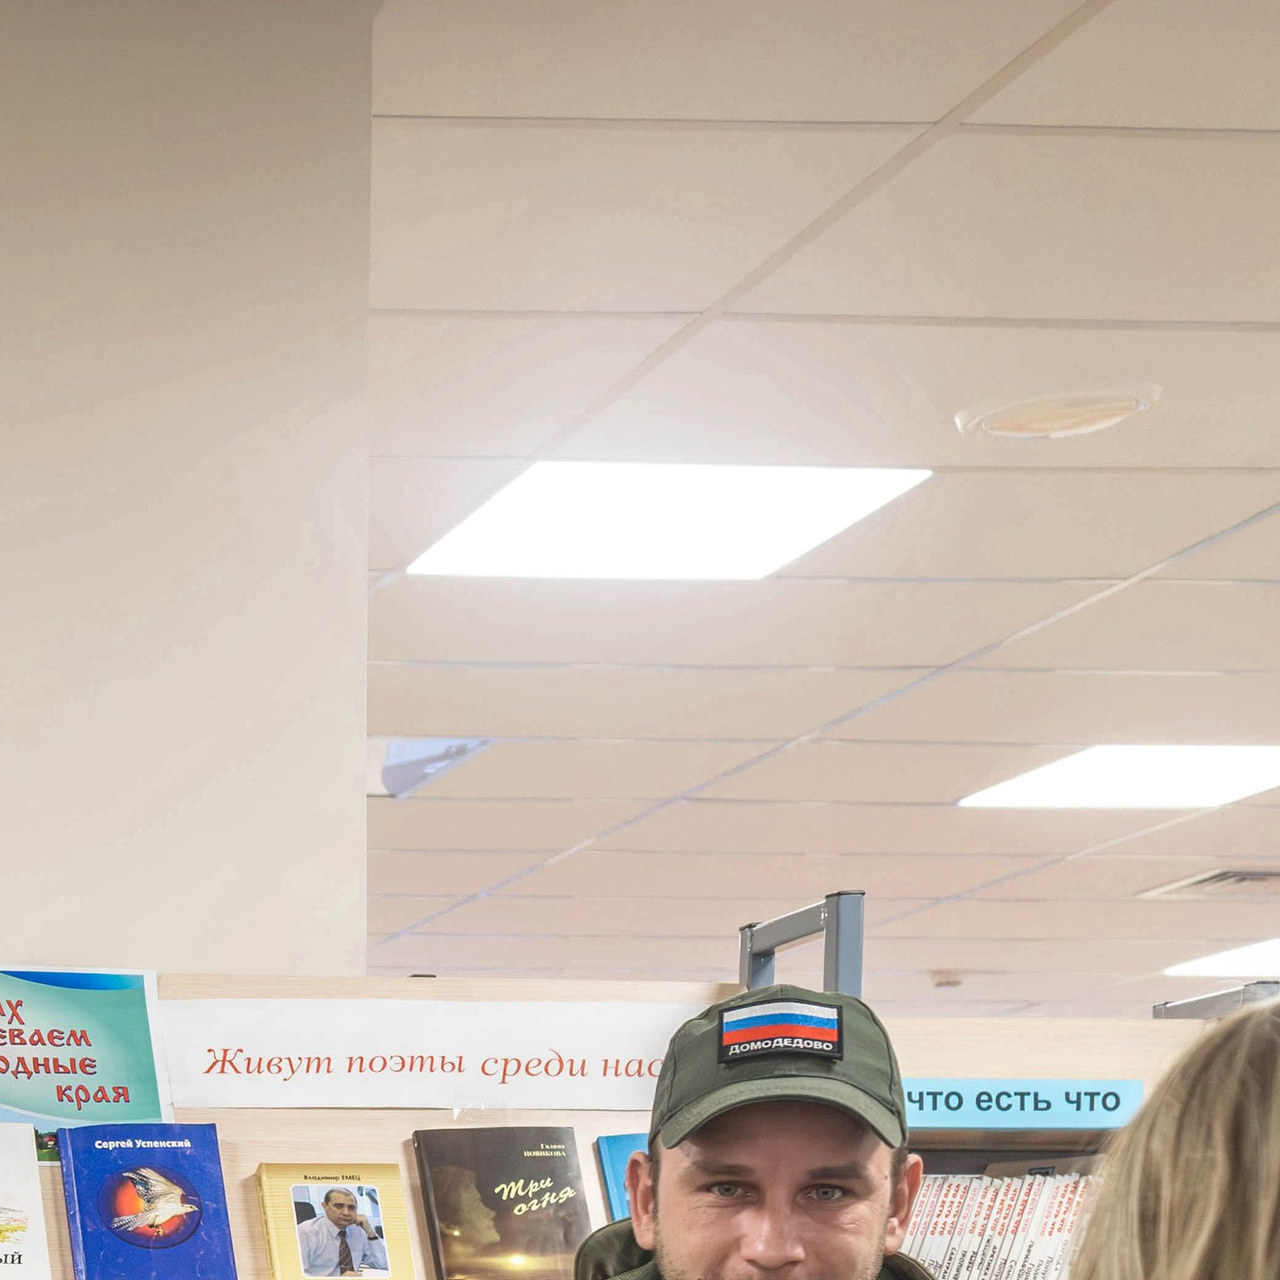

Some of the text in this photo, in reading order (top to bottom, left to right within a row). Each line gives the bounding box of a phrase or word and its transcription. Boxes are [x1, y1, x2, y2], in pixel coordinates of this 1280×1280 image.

[729, 1037, 833, 1055] ДОМОДЕДОВО
[203, 1048, 663, 1084] Живут поэты среди нас
[56, 1085, 130, 1111] края
[907, 1091, 1120, 1112] что есть что
[94, 1139, 191, 1151] Сергей Успенский
[341, 1174, 361, 1182] ЕМЕЦ
[494, 1177, 553, 1200] Три
[513, 1186, 577, 1215] огня
